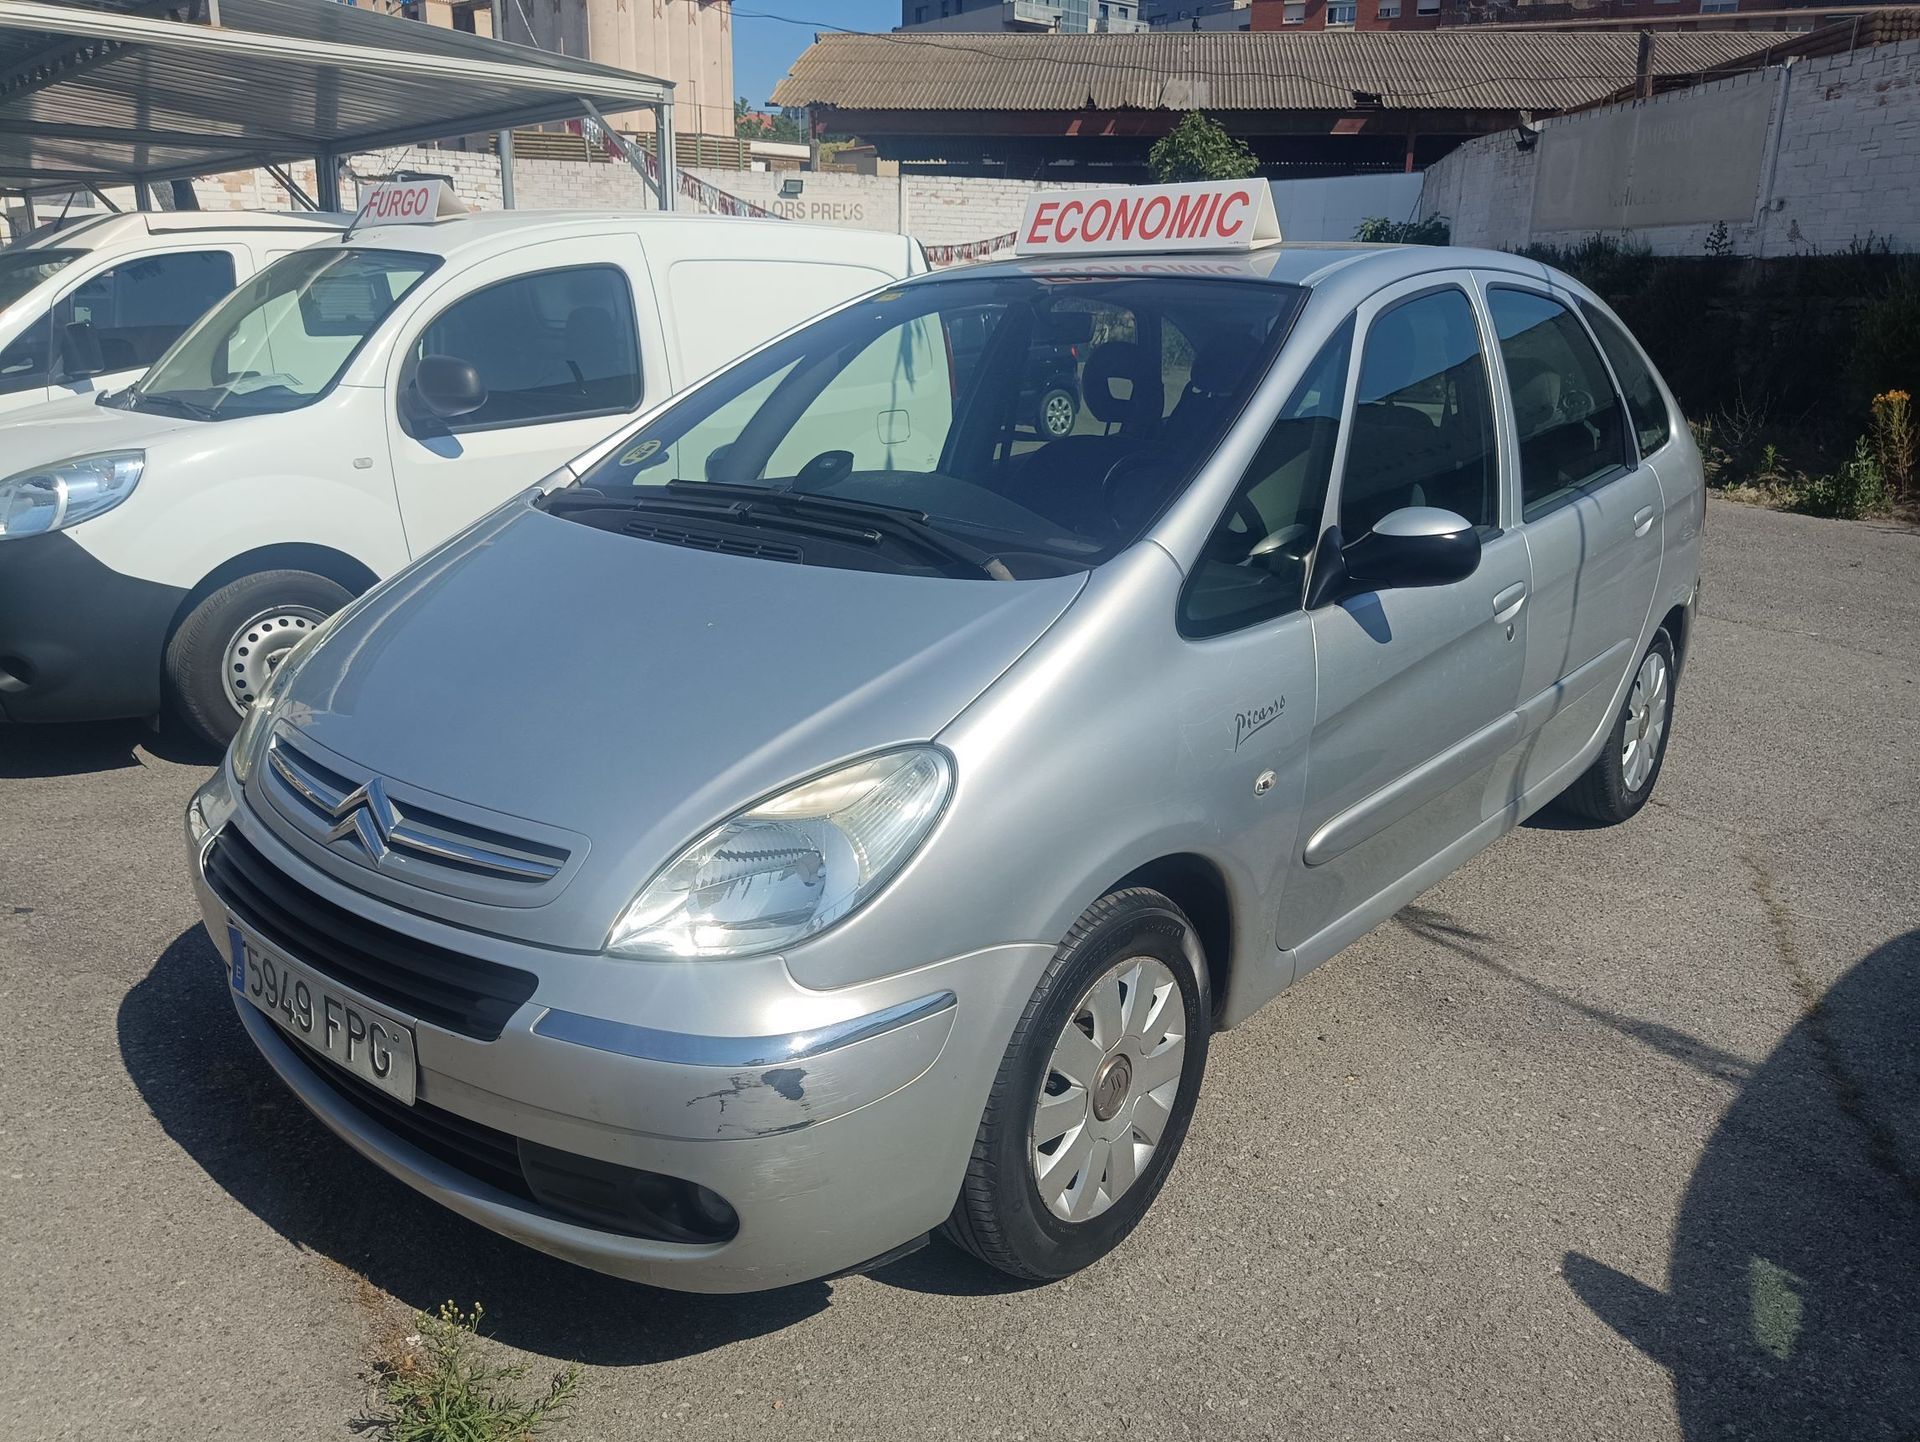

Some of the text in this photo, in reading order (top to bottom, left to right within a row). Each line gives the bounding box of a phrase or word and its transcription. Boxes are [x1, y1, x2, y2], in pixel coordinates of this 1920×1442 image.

[365, 187, 429, 218] FURGO
[810, 202, 864, 221] PREUS
[1026, 190, 1250, 244] ECONOMIC
[1234, 695, 1286, 753] Picasso
[235, 965, 242, 980] E
[247, 946, 393, 1079] 5949 FPG
